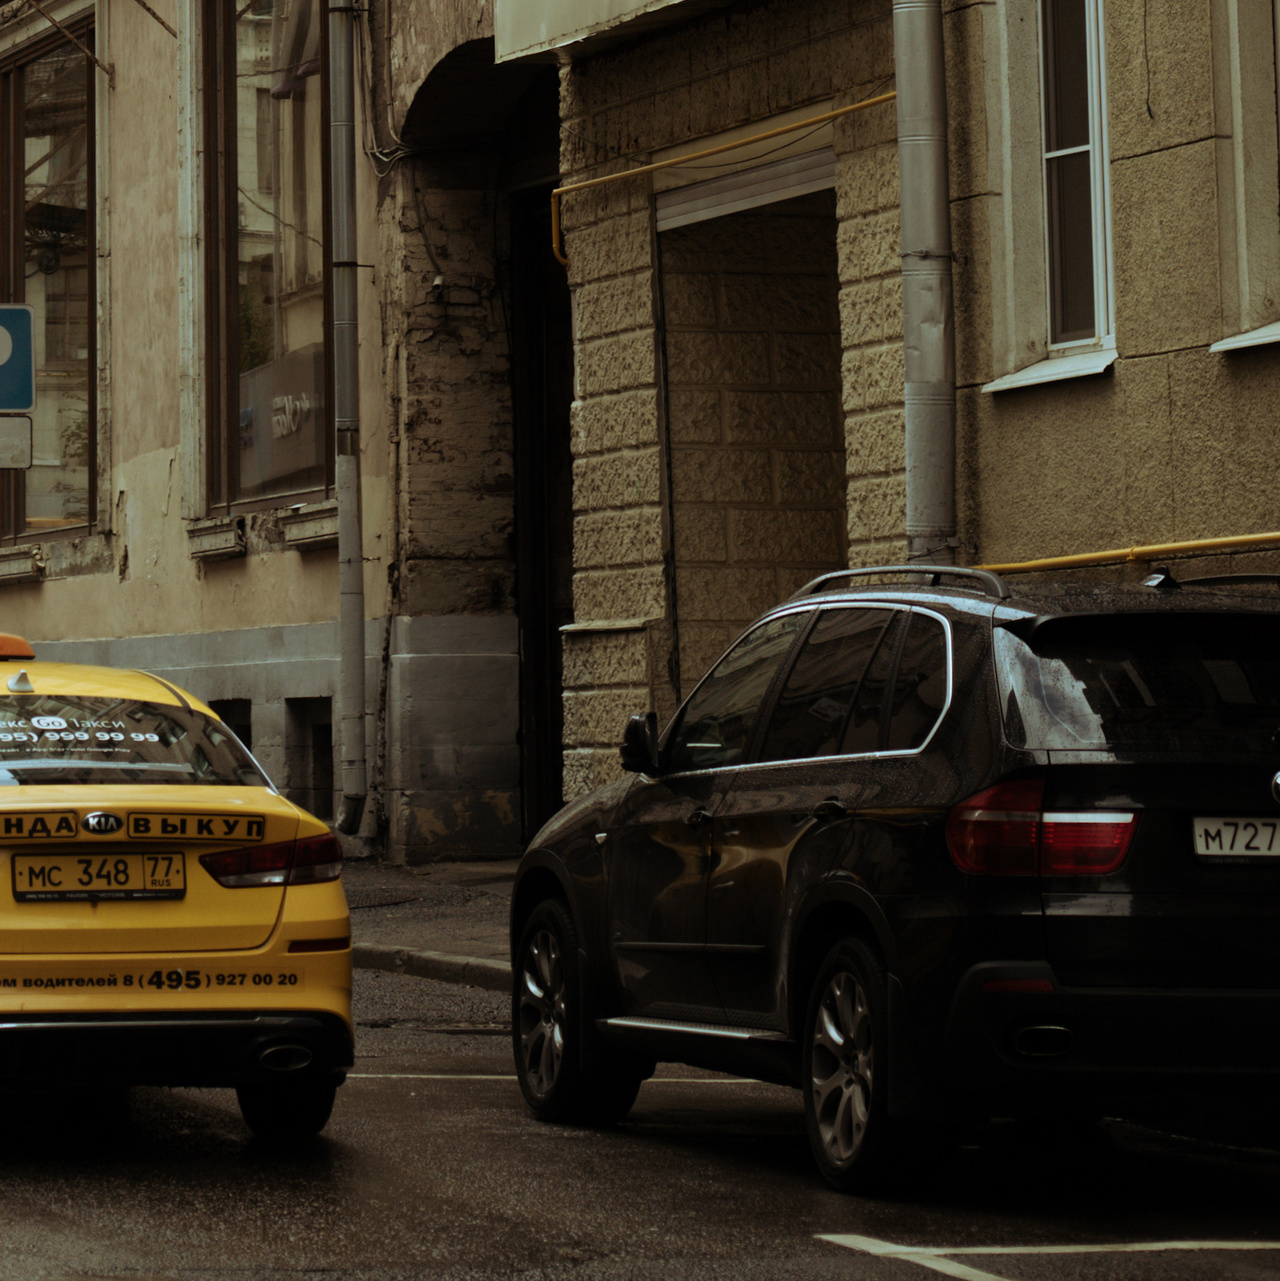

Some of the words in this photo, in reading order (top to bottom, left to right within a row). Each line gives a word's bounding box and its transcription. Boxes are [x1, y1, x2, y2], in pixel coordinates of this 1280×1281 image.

[45, 732, 90, 741] 999
[95, 732, 125, 741] 99
[130, 732, 160, 742] 99
[89, 817, 118, 830] KIA
[133, 817, 263, 837] ВЫКУП
[77, 859, 129, 887] 348
[147, 857, 173, 878] 77
[151, 879, 171, 887] RUS
[22, 974, 117, 989] водителей
[123, 975, 134, 986] 8
[216, 974, 247, 986] 927
[252, 974, 273, 986] 00
[278, 974, 298, 986] 20
